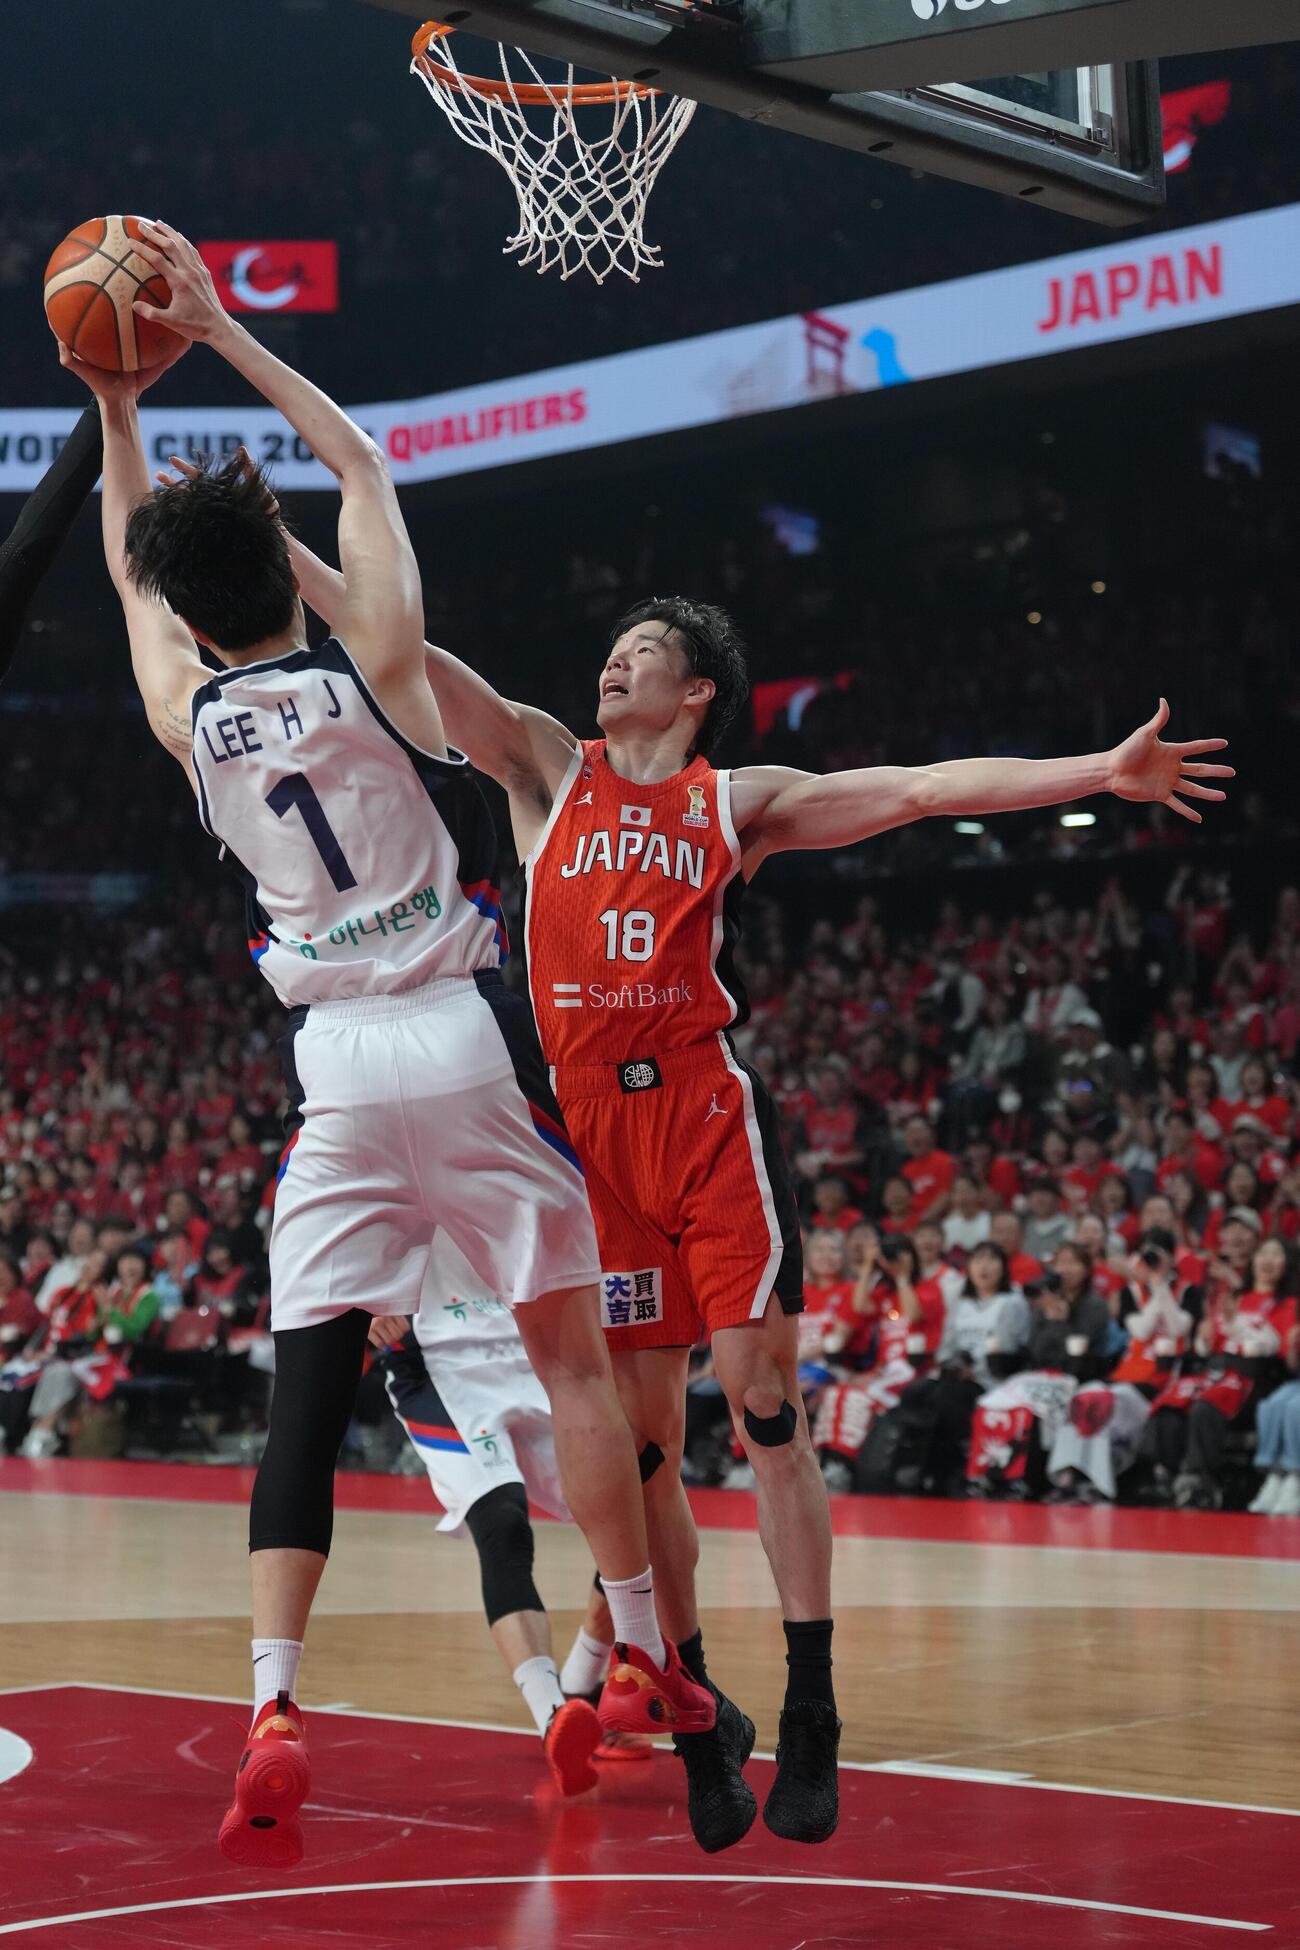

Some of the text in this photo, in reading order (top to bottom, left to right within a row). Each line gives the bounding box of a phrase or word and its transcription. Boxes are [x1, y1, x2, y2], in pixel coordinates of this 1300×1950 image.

[1037, 244, 1223, 333] JAPAN
[388, 388, 588, 462] QUALIFIERS
[201, 711, 263, 764] LEE
[277, 697, 304, 741] H
[322, 678, 342, 719] J
[264, 772, 358, 893] 1
[560, 829, 706, 890] JAPAN
[328, 886, 442, 946] 하나은행
[598, 908, 657, 963] 18
[588, 979, 693, 1009] SoftBank
